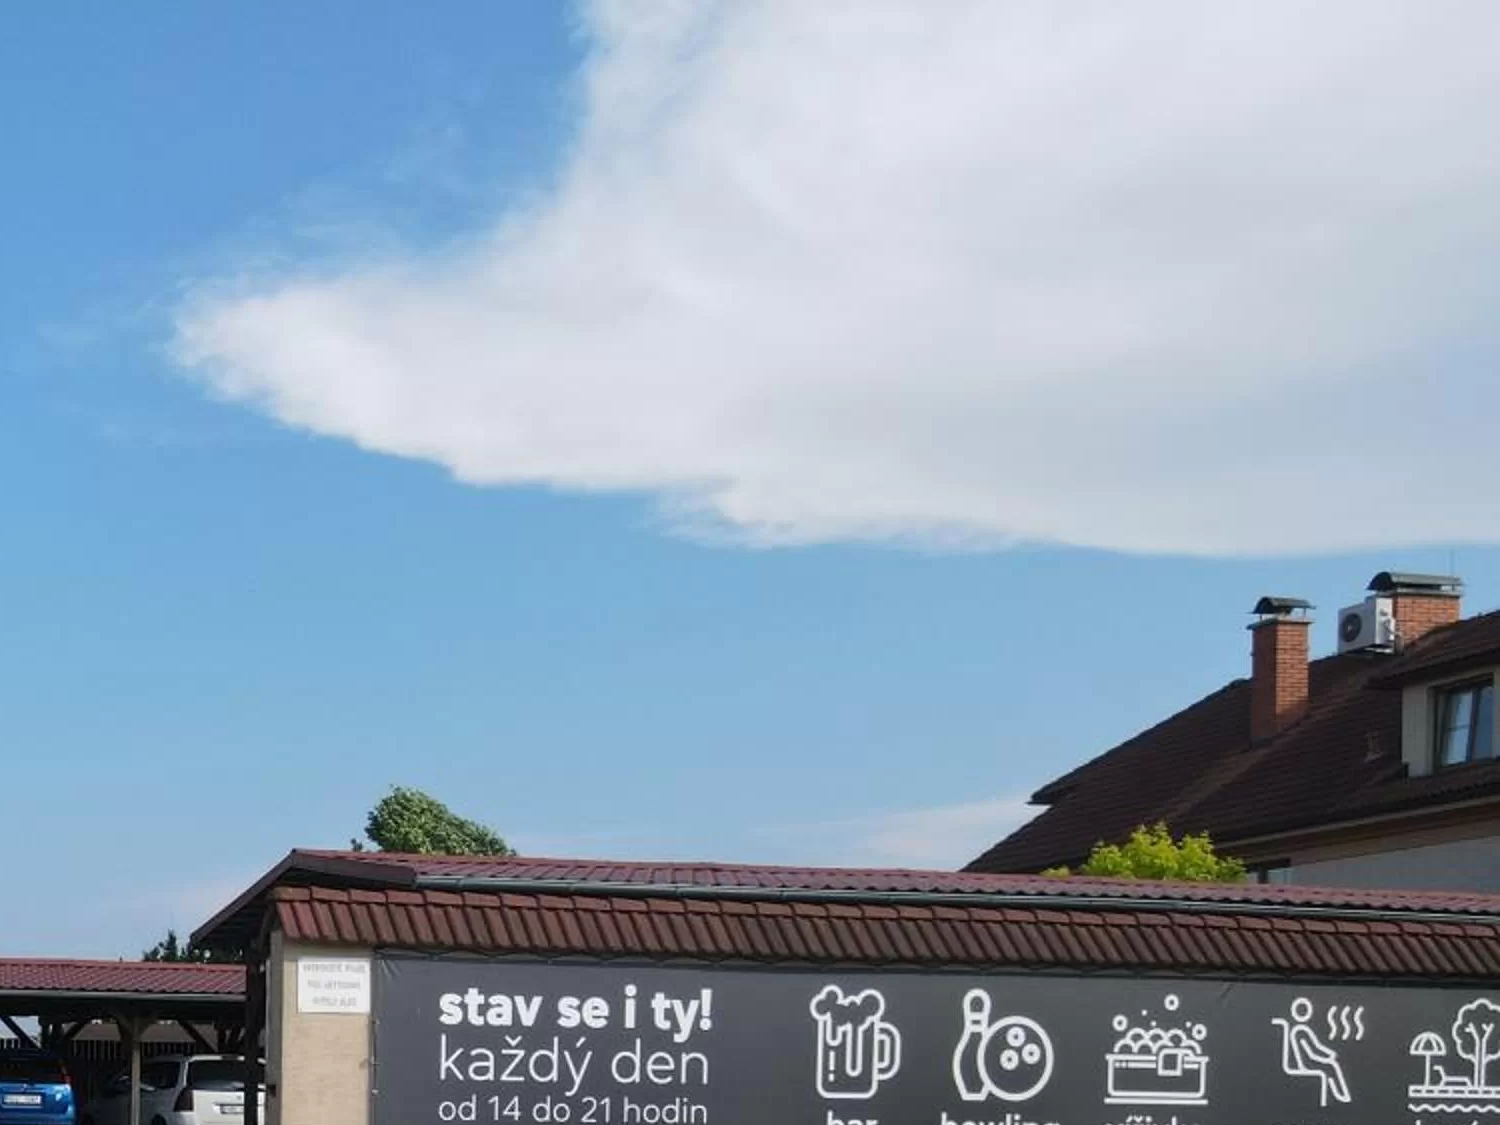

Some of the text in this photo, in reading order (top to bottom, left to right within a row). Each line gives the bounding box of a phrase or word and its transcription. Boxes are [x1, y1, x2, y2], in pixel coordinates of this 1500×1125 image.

[439, 984, 712, 1042] stav se i ty!
[440, 1034, 708, 1097] každý den
[439, 1094, 707, 1124] od 14 do 21 hodin
